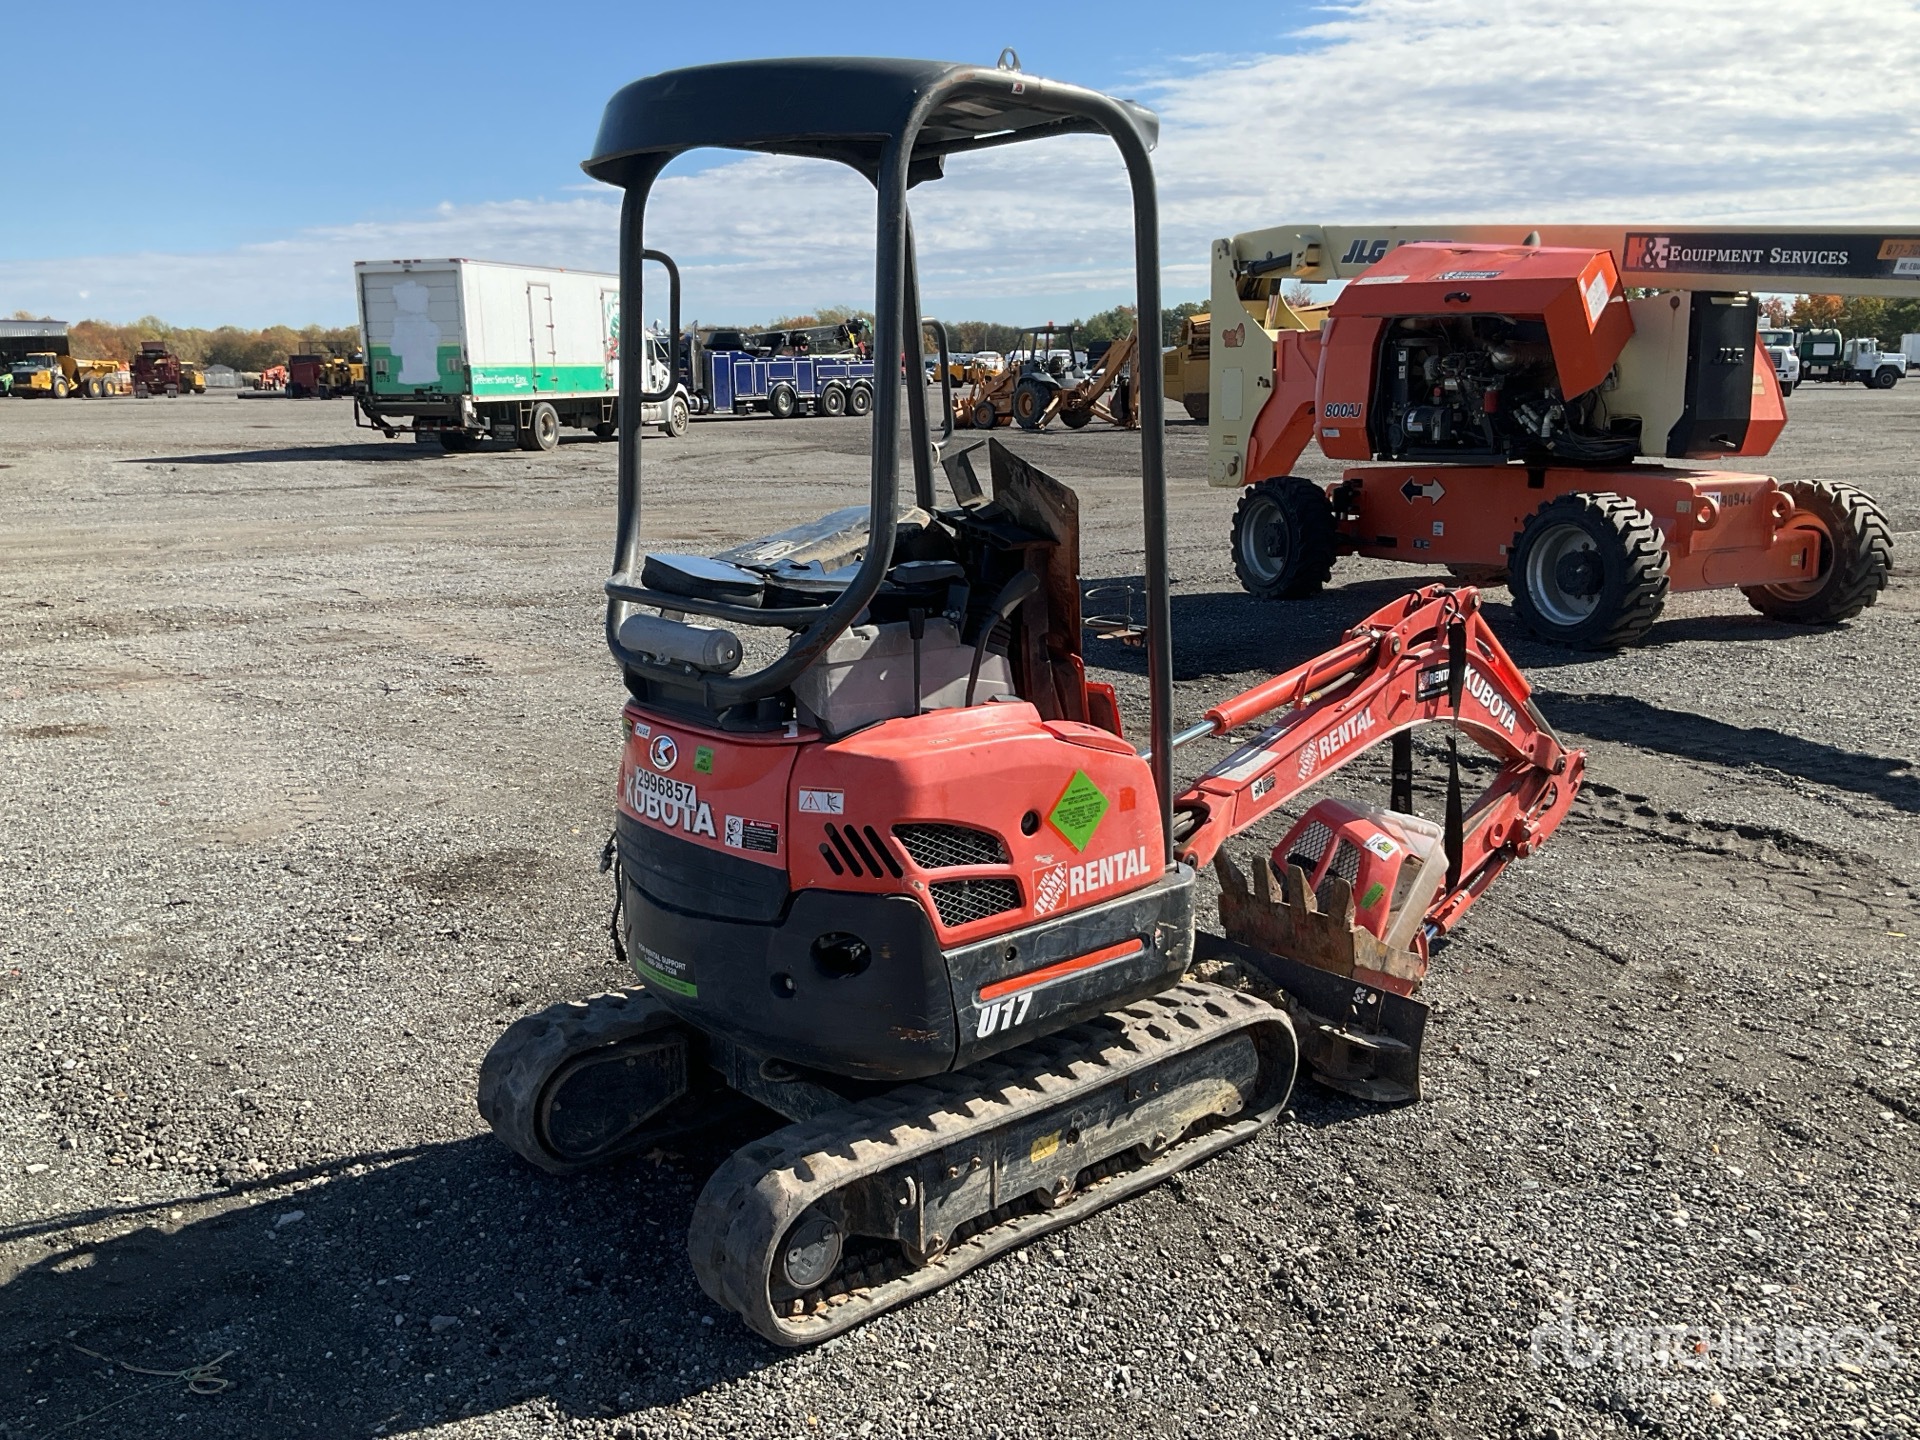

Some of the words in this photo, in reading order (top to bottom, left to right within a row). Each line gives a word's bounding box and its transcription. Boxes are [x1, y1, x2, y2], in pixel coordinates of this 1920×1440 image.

[1341, 239, 1390, 264] JLG
[1625, 236, 1670, 269] H&E
[1669, 245, 1764, 263] EQUIPMENT
[1769, 247, 1849, 265] SERVICES
[1324, 402, 1363, 419] 800AJ
[1463, 662, 1517, 734] KUBOTA
[1319, 706, 1376, 761] RENTAL
[625, 774, 718, 838] KUBOTA
[637, 768, 694, 804] 2996857
[1034, 863, 1067, 915] HOME
[1069, 845, 1151, 897] RENTAL
[661, 955, 686, 971] SUPPORT
[976, 991, 1033, 1038] U17
